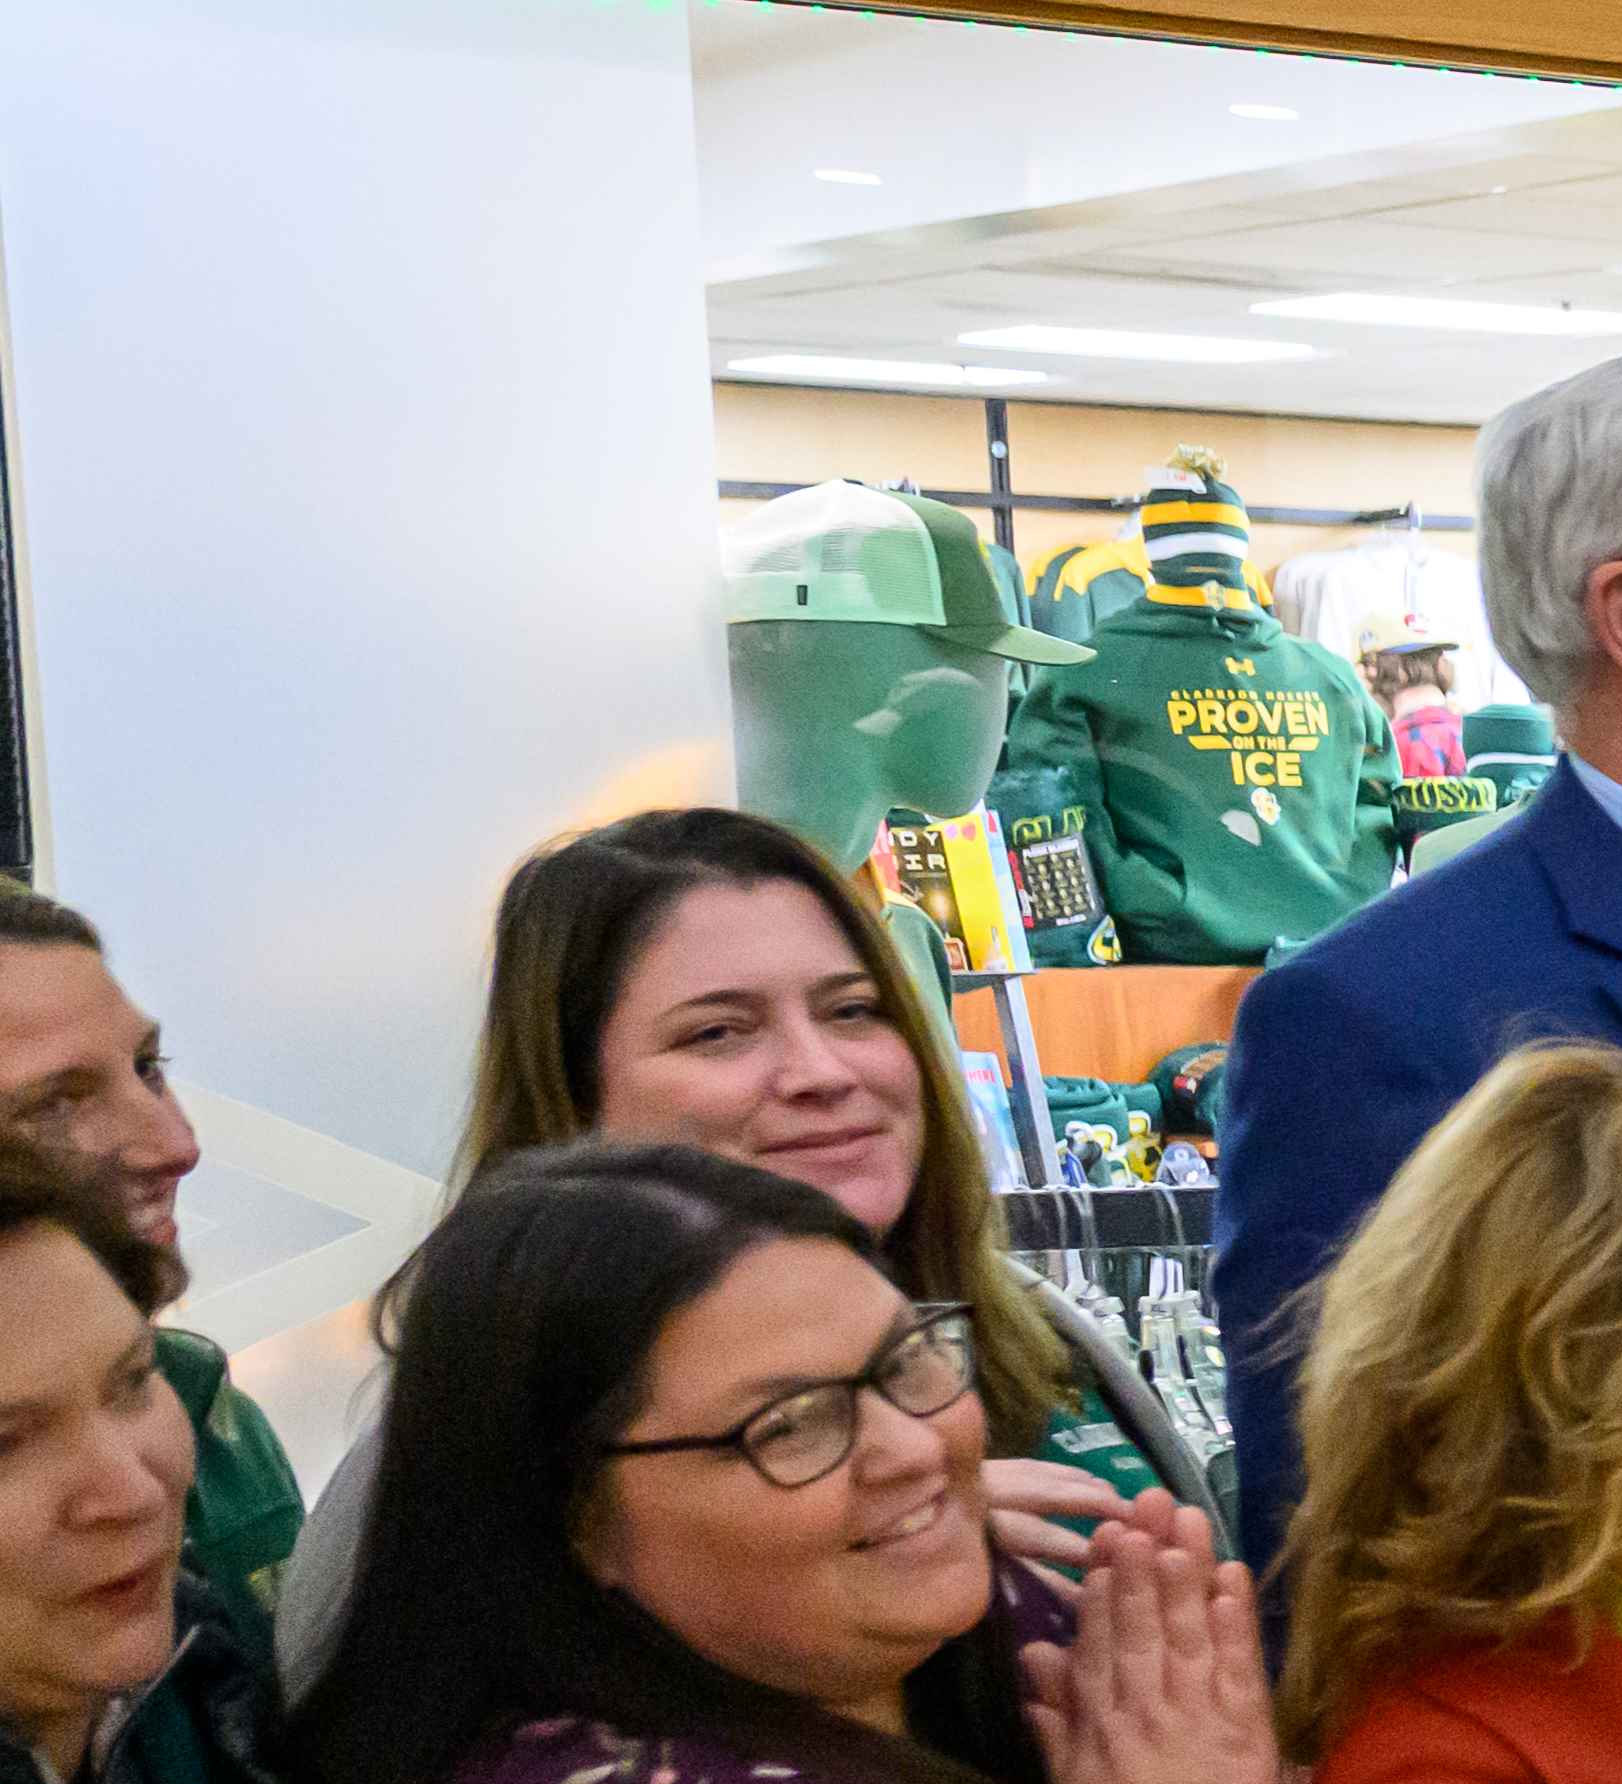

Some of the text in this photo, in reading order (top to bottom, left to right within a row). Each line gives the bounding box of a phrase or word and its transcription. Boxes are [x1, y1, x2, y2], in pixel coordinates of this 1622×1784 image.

[1167, 700, 1329, 736] PROVEN
[1231, 736, 1256, 750] ON
[1231, 751, 1303, 787] ICE
